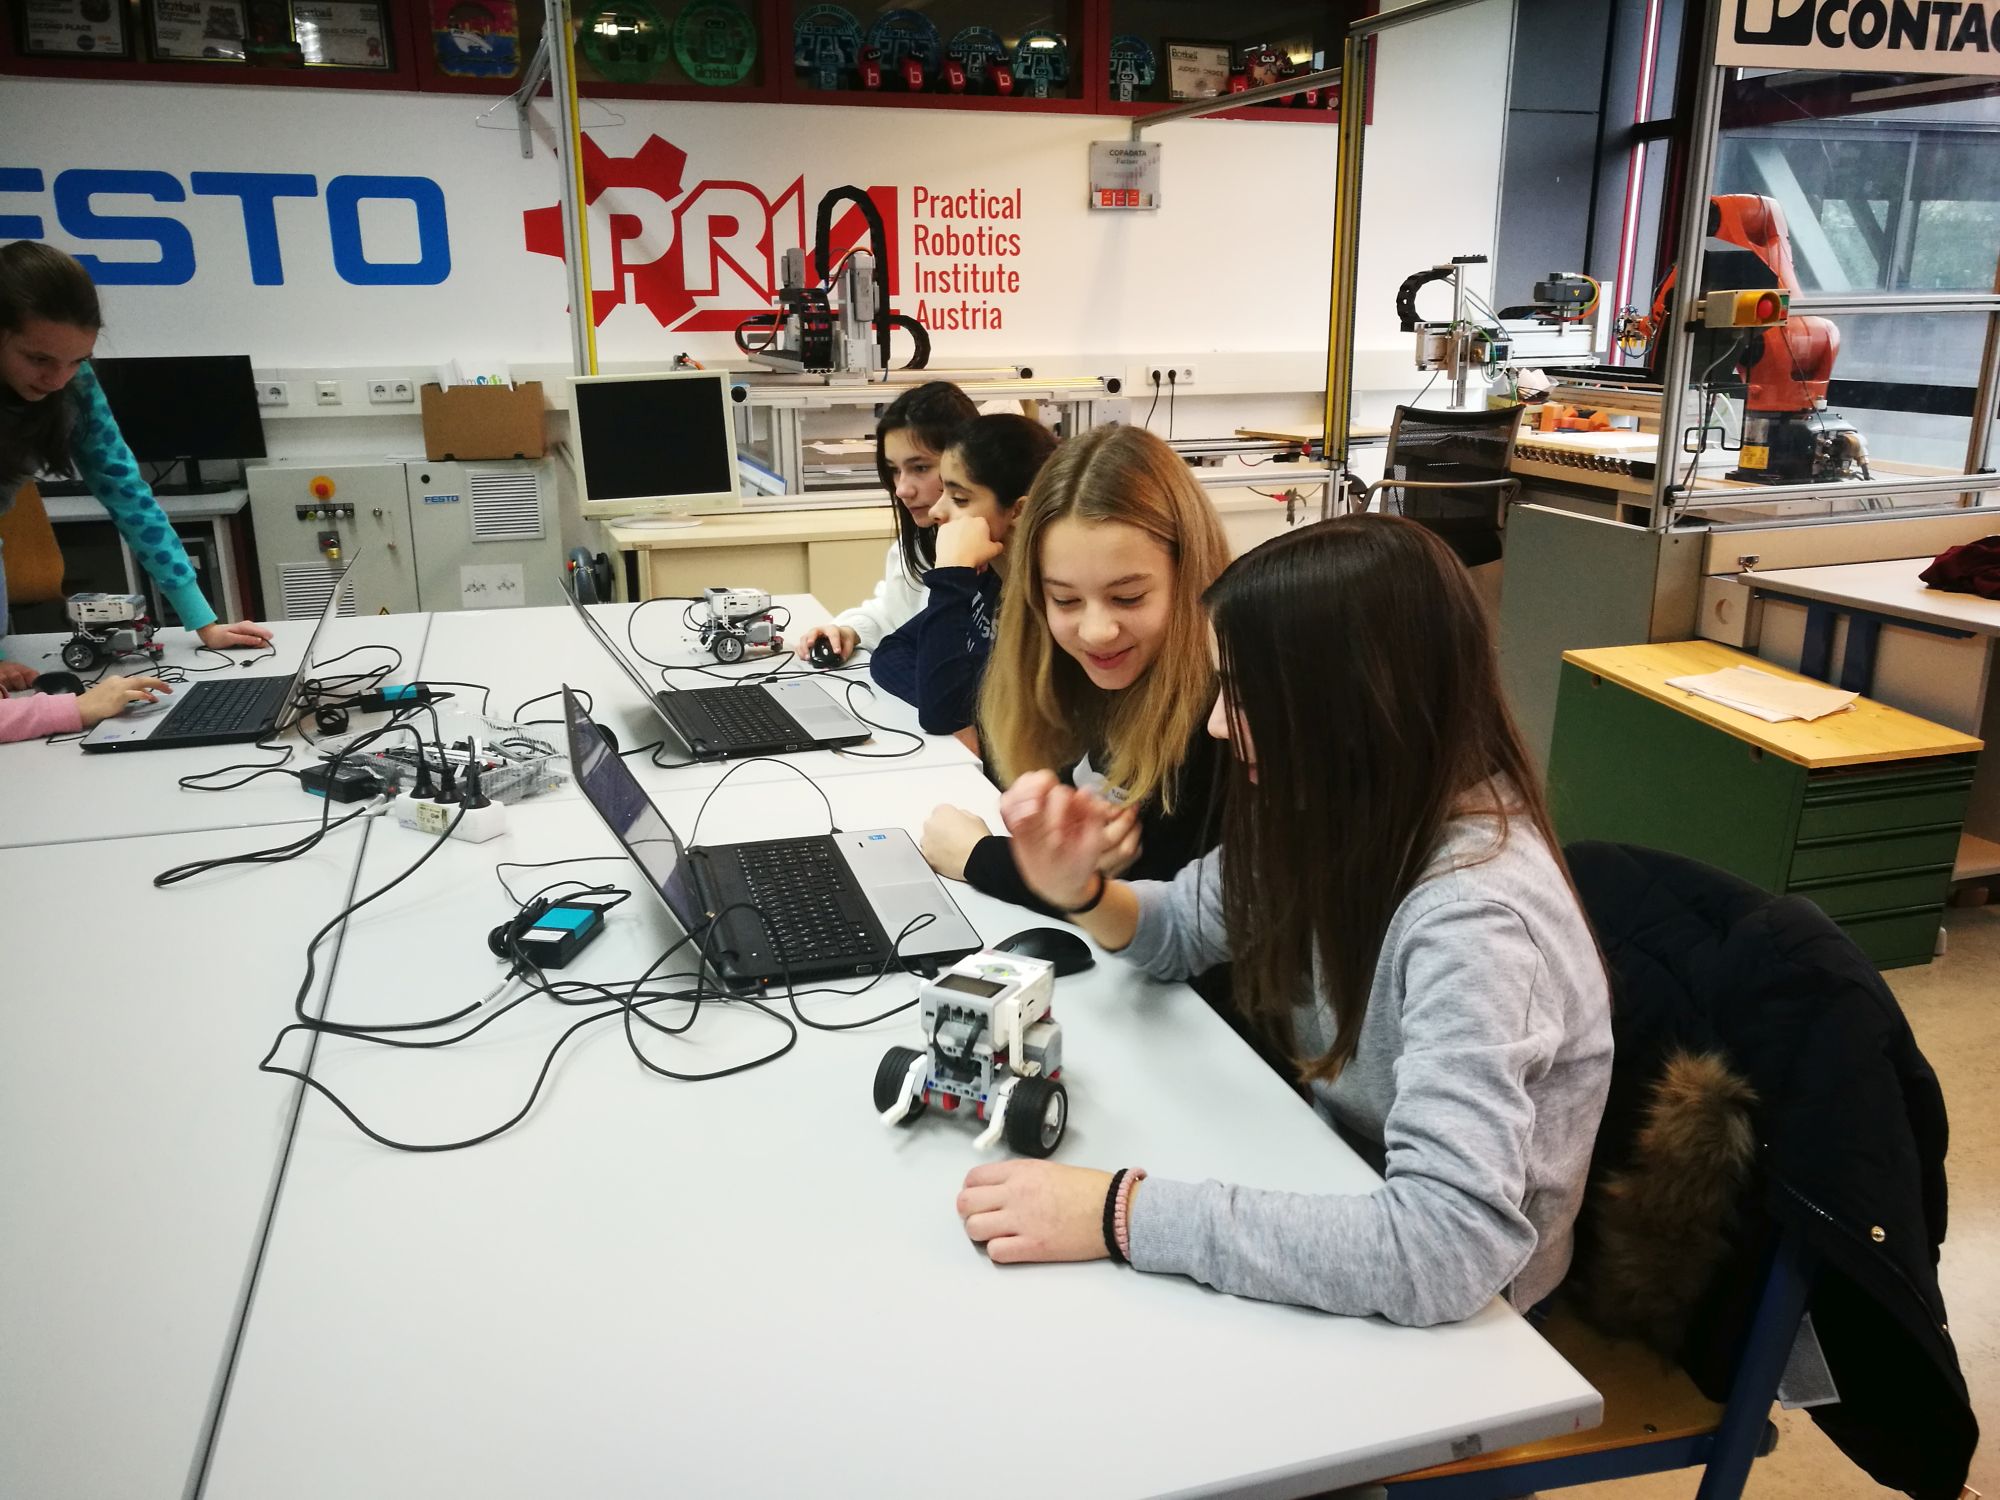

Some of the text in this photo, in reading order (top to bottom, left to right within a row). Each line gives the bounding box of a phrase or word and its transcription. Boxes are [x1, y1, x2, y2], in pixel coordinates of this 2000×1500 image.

[64, 24, 92, 32] PLACE
[1816, 0, 2000, 52] CONTA
[1108, 149, 1147, 157] COPADATA
[913, 186, 1022, 219] Practical
[914, 224, 1021, 256] Robotics
[915, 262, 1020, 293] Institute
[916, 299, 1002, 330] Austria
[424, 494, 460, 503] FESTO
